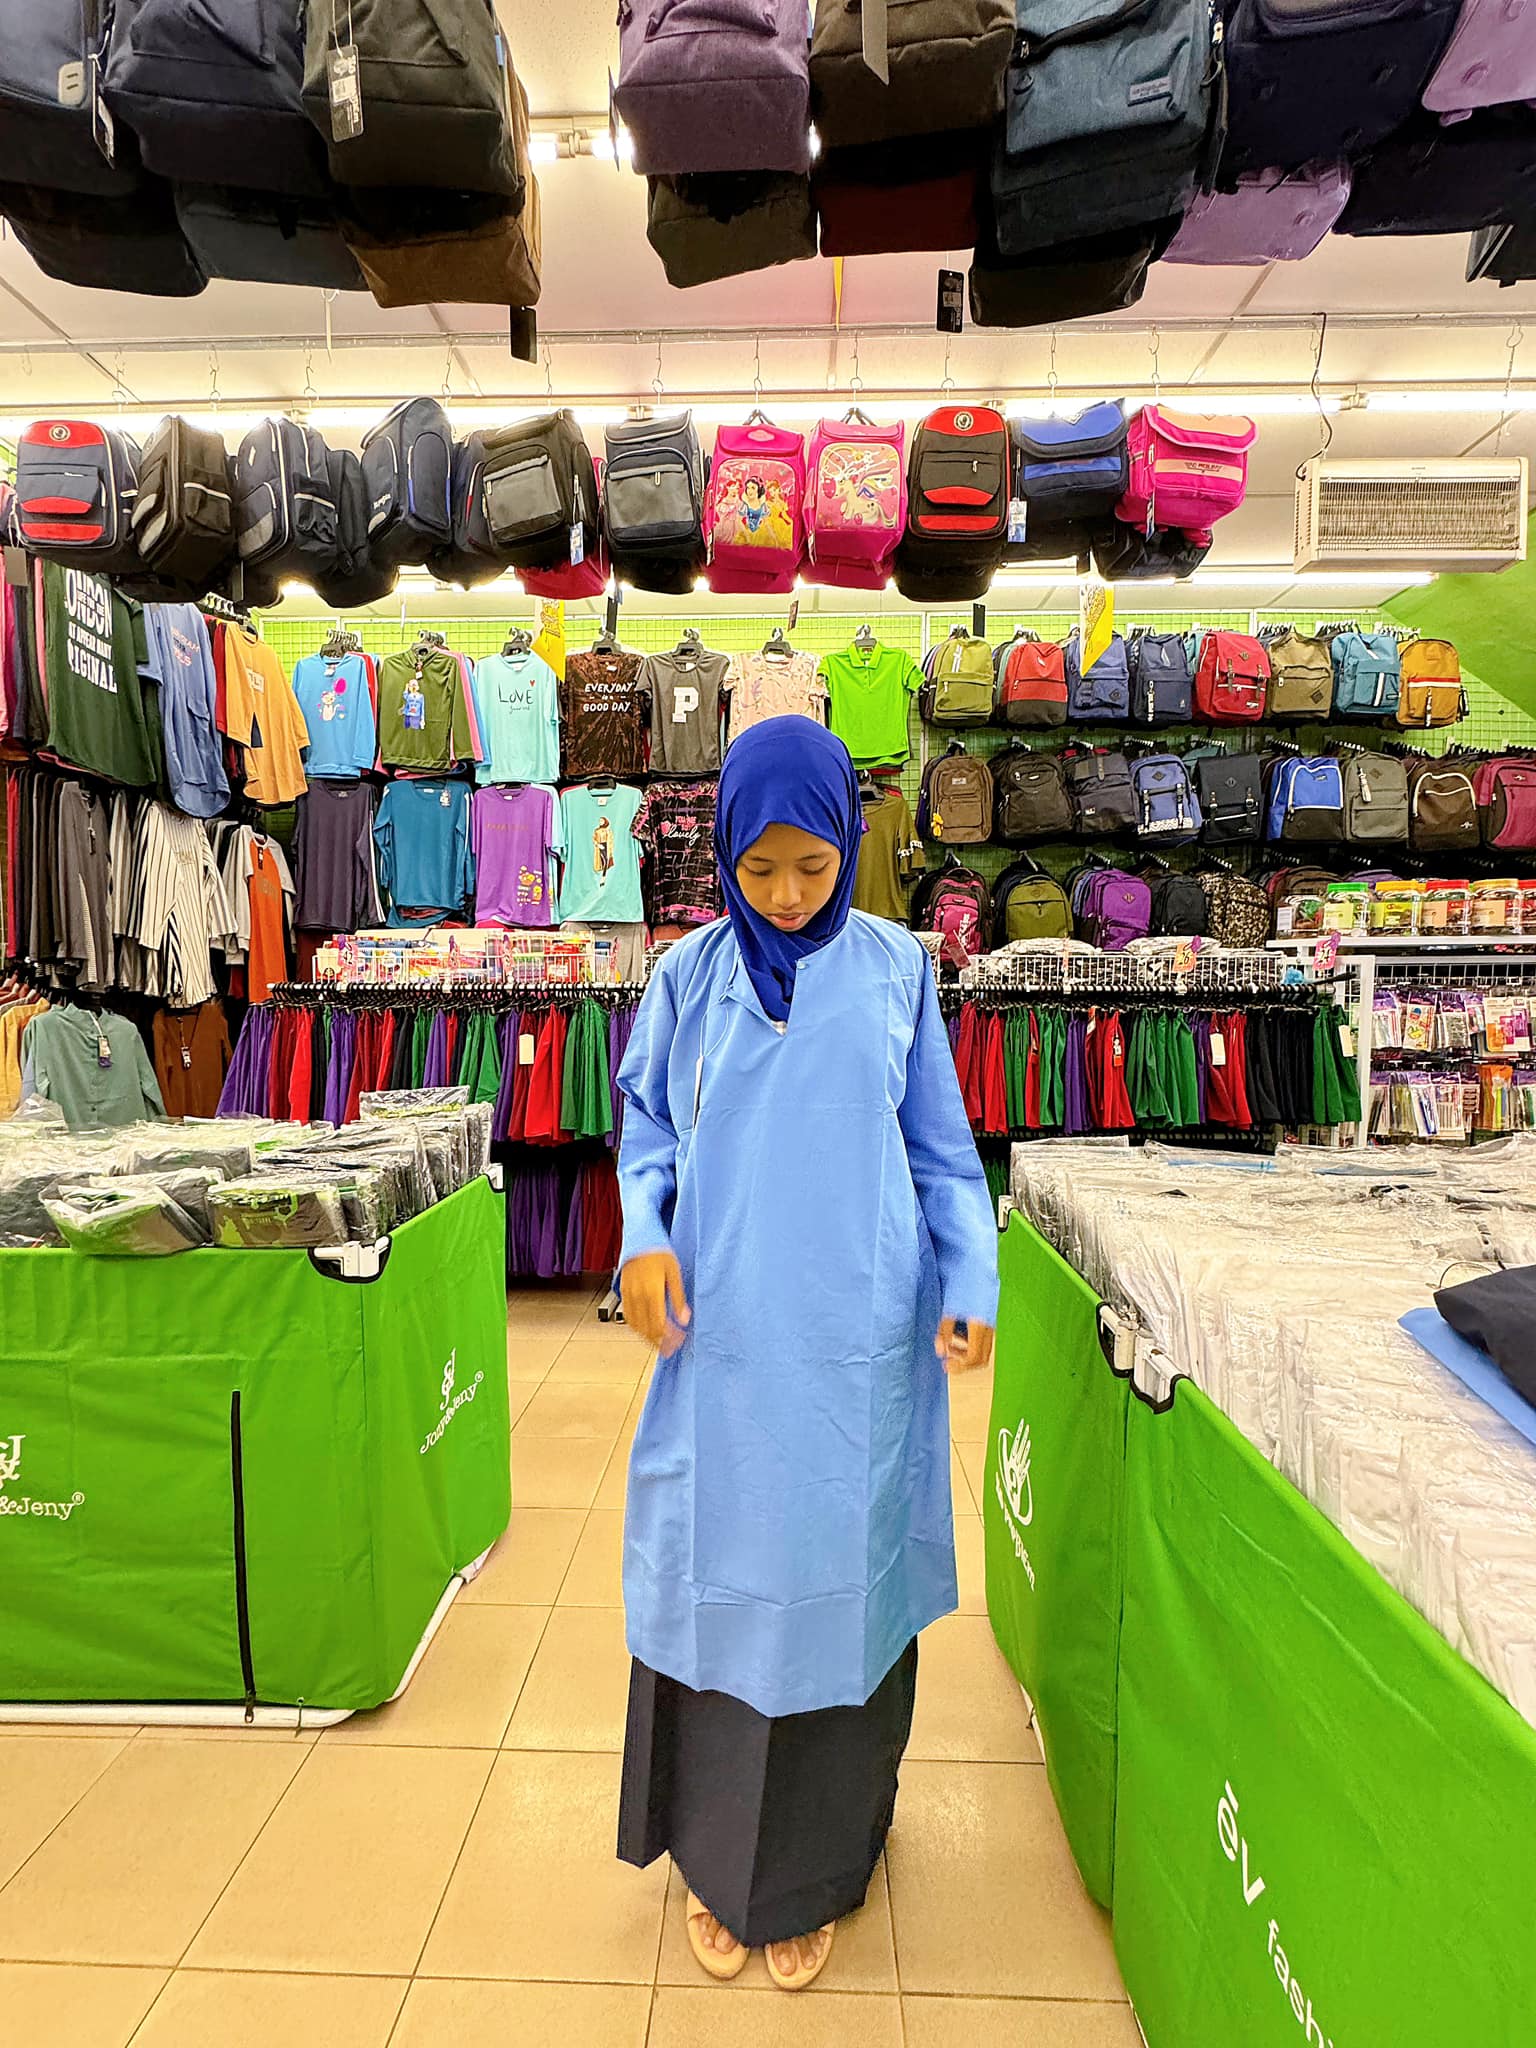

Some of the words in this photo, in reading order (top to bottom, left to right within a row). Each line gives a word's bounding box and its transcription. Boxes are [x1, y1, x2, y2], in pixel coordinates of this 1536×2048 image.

[64, 568, 112, 638] ONDON
[584, 683, 633, 693] EVERYDAY
[583, 703, 609, 712] GOOD
[611, 702, 632, 712] DAY
[672, 687, 699, 722] P
[663, 824, 701, 847] lovely
[1268, 1918, 1334, 2048] fash
